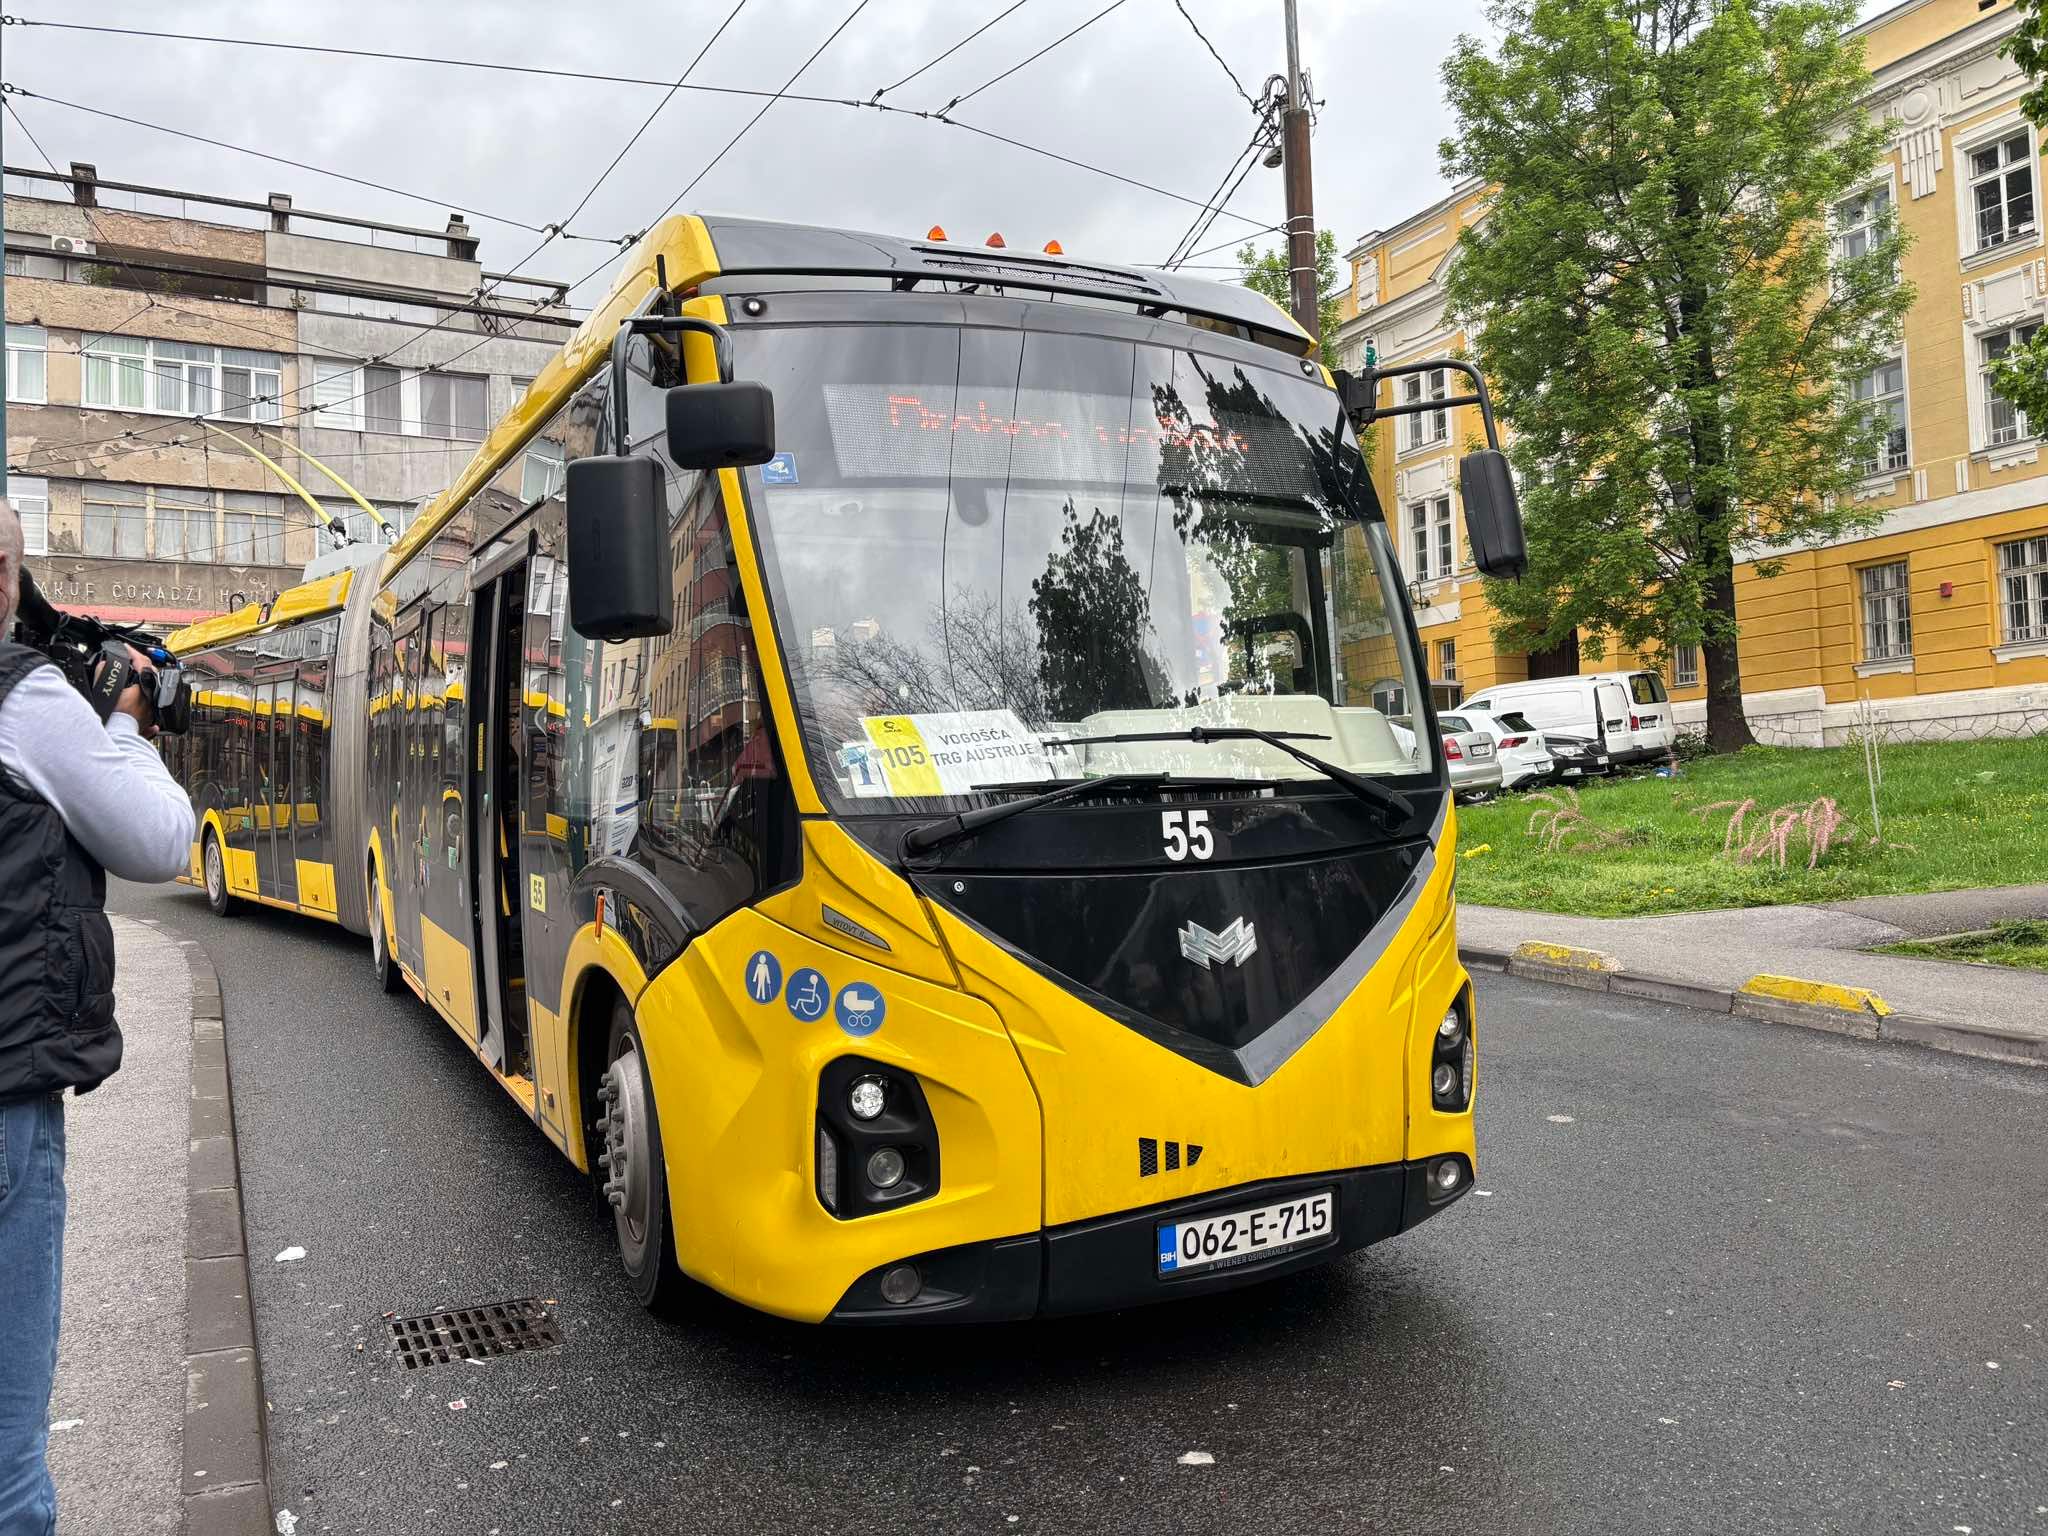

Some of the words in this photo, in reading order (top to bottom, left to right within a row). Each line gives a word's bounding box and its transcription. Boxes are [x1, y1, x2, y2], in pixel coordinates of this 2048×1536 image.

[102, 660, 123, 697] SONY
[938, 728, 1012, 746] VOGOŠĆA
[881, 744, 927, 769] 105
[930, 750, 963, 768] TRG
[966, 743, 1035, 764] AUSTRIJE
[1161, 809, 1215, 862] 55
[533, 879, 543, 905] 55
[1182, 1198, 1328, 1261] 062-E-715
[1160, 1251, 1177, 1264] BIH
[1216, 1254, 1248, 1269] WIENER
